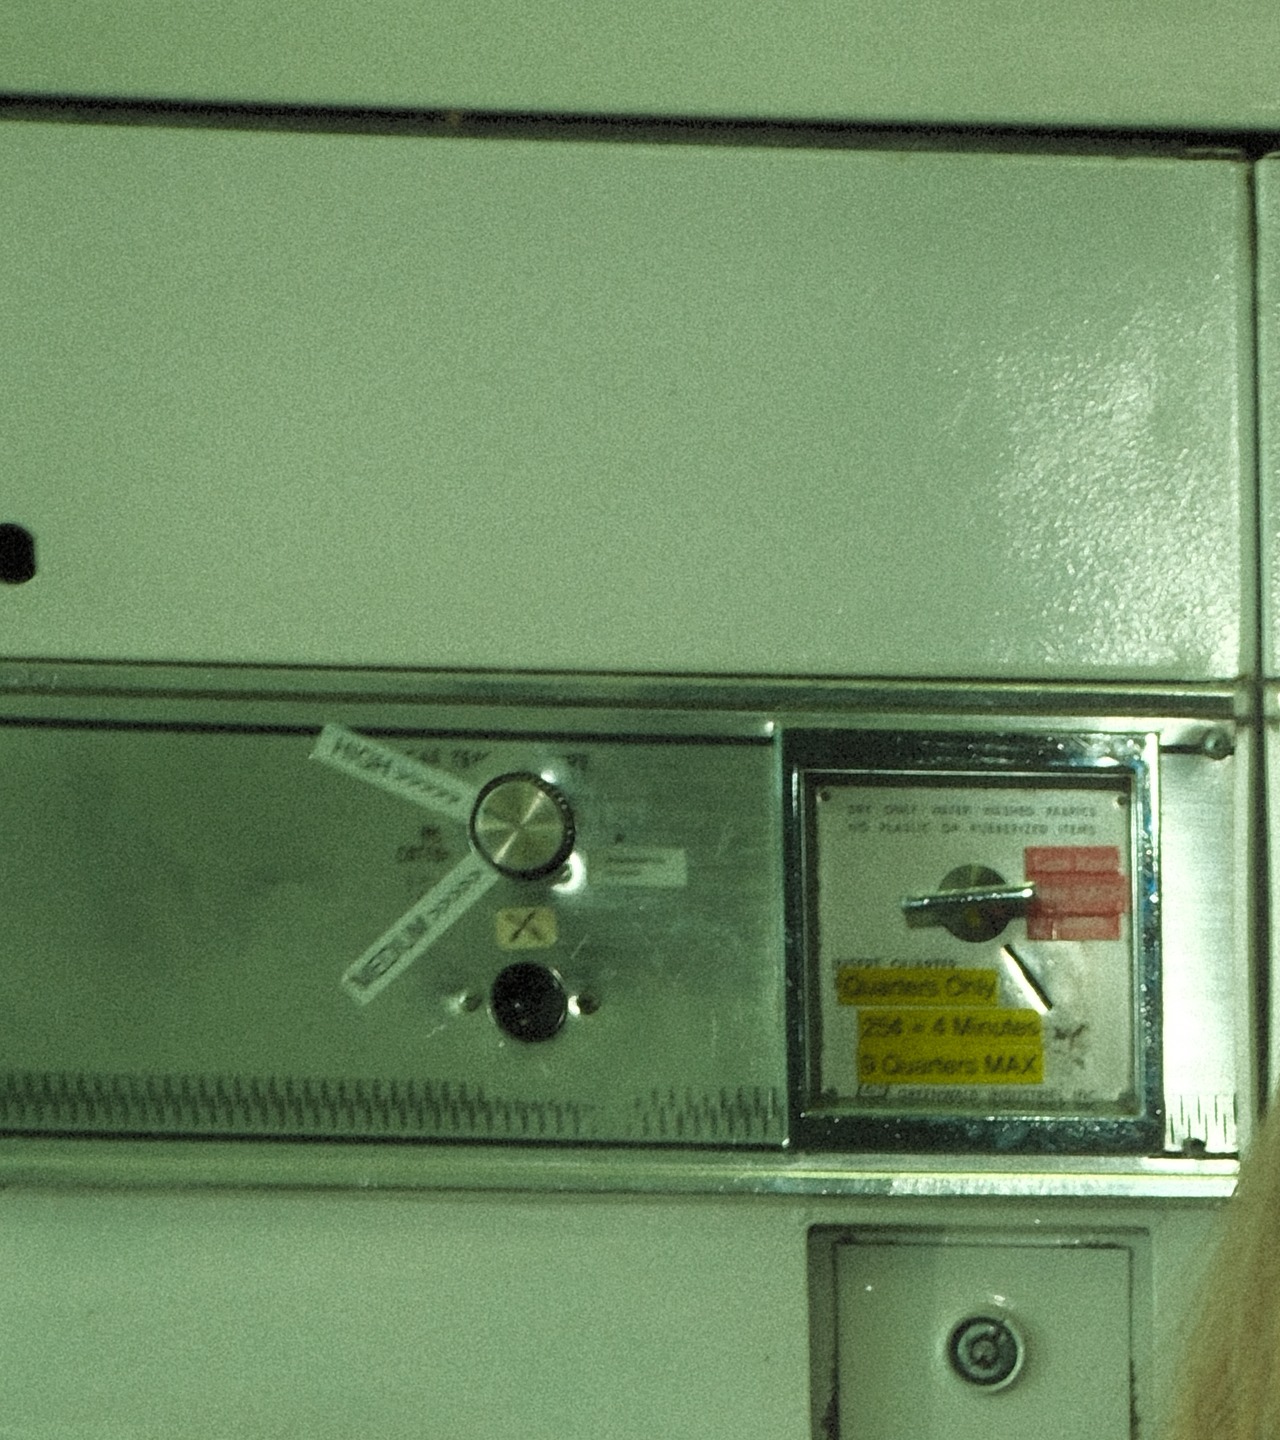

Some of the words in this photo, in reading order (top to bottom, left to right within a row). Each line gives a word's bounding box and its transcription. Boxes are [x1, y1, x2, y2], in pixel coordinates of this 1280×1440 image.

[846, 803, 873, 816] DRY
[883, 804, 919, 816] ONLY
[847, 821, 870, 834] NO
[879, 822, 930, 834] PLASTIC
[1057, 823, 1097, 836] ITEMS
[843, 973, 939, 997] Quarters
[945, 974, 995, 999] Only
[932, 1017, 946, 1035] 4
[952, 1016, 1039, 1037] Minutes
[881, 1055, 978, 1076] Quarters
[985, 1056, 1038, 1074] MAX
